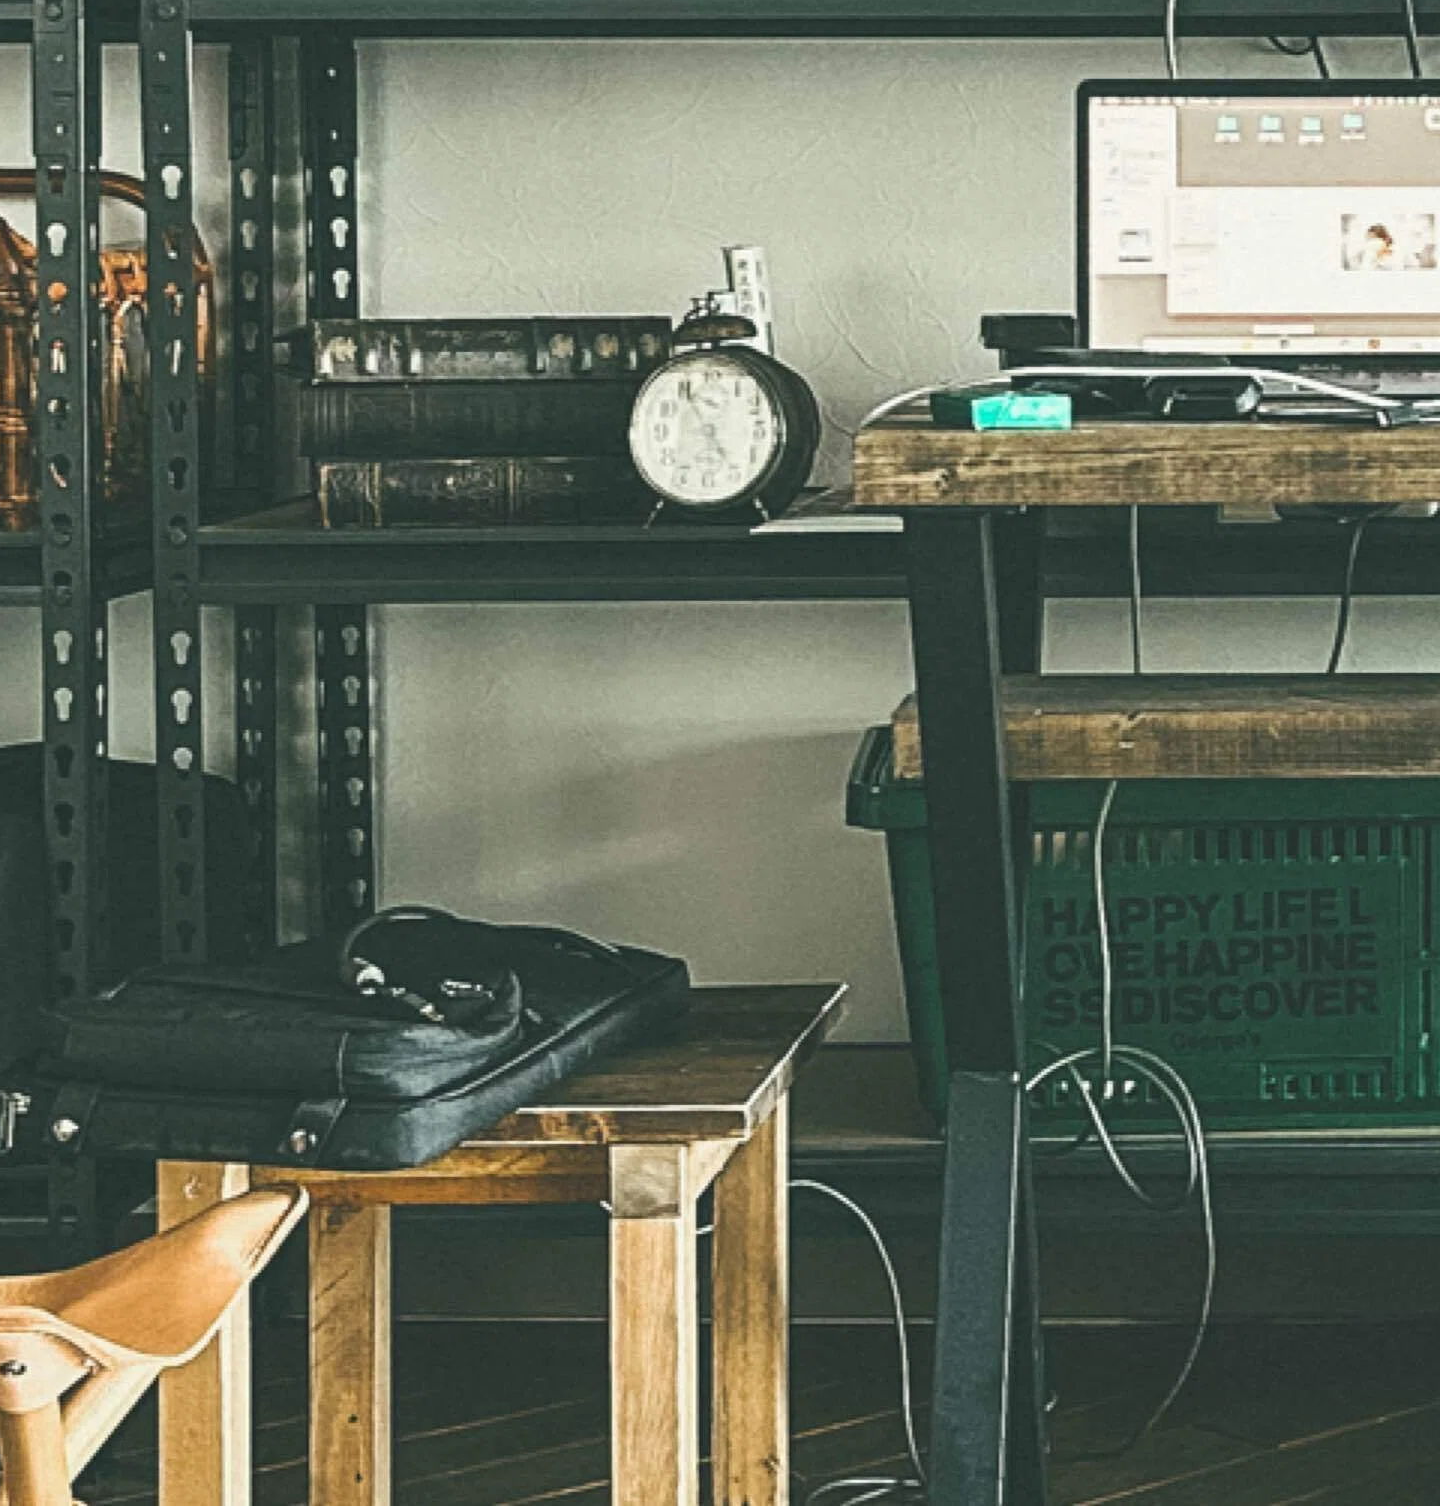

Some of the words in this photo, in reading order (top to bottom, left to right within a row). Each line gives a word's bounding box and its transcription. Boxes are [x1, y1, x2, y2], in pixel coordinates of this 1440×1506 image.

[1042, 892, 1220, 936] HAPPY
[1233, 887, 1341, 931] LIFE
[1349, 887, 1374, 926] L
[1154, 931, 1378, 978] HAPPINE
[1122, 977, 1380, 1026] DISCOVER
